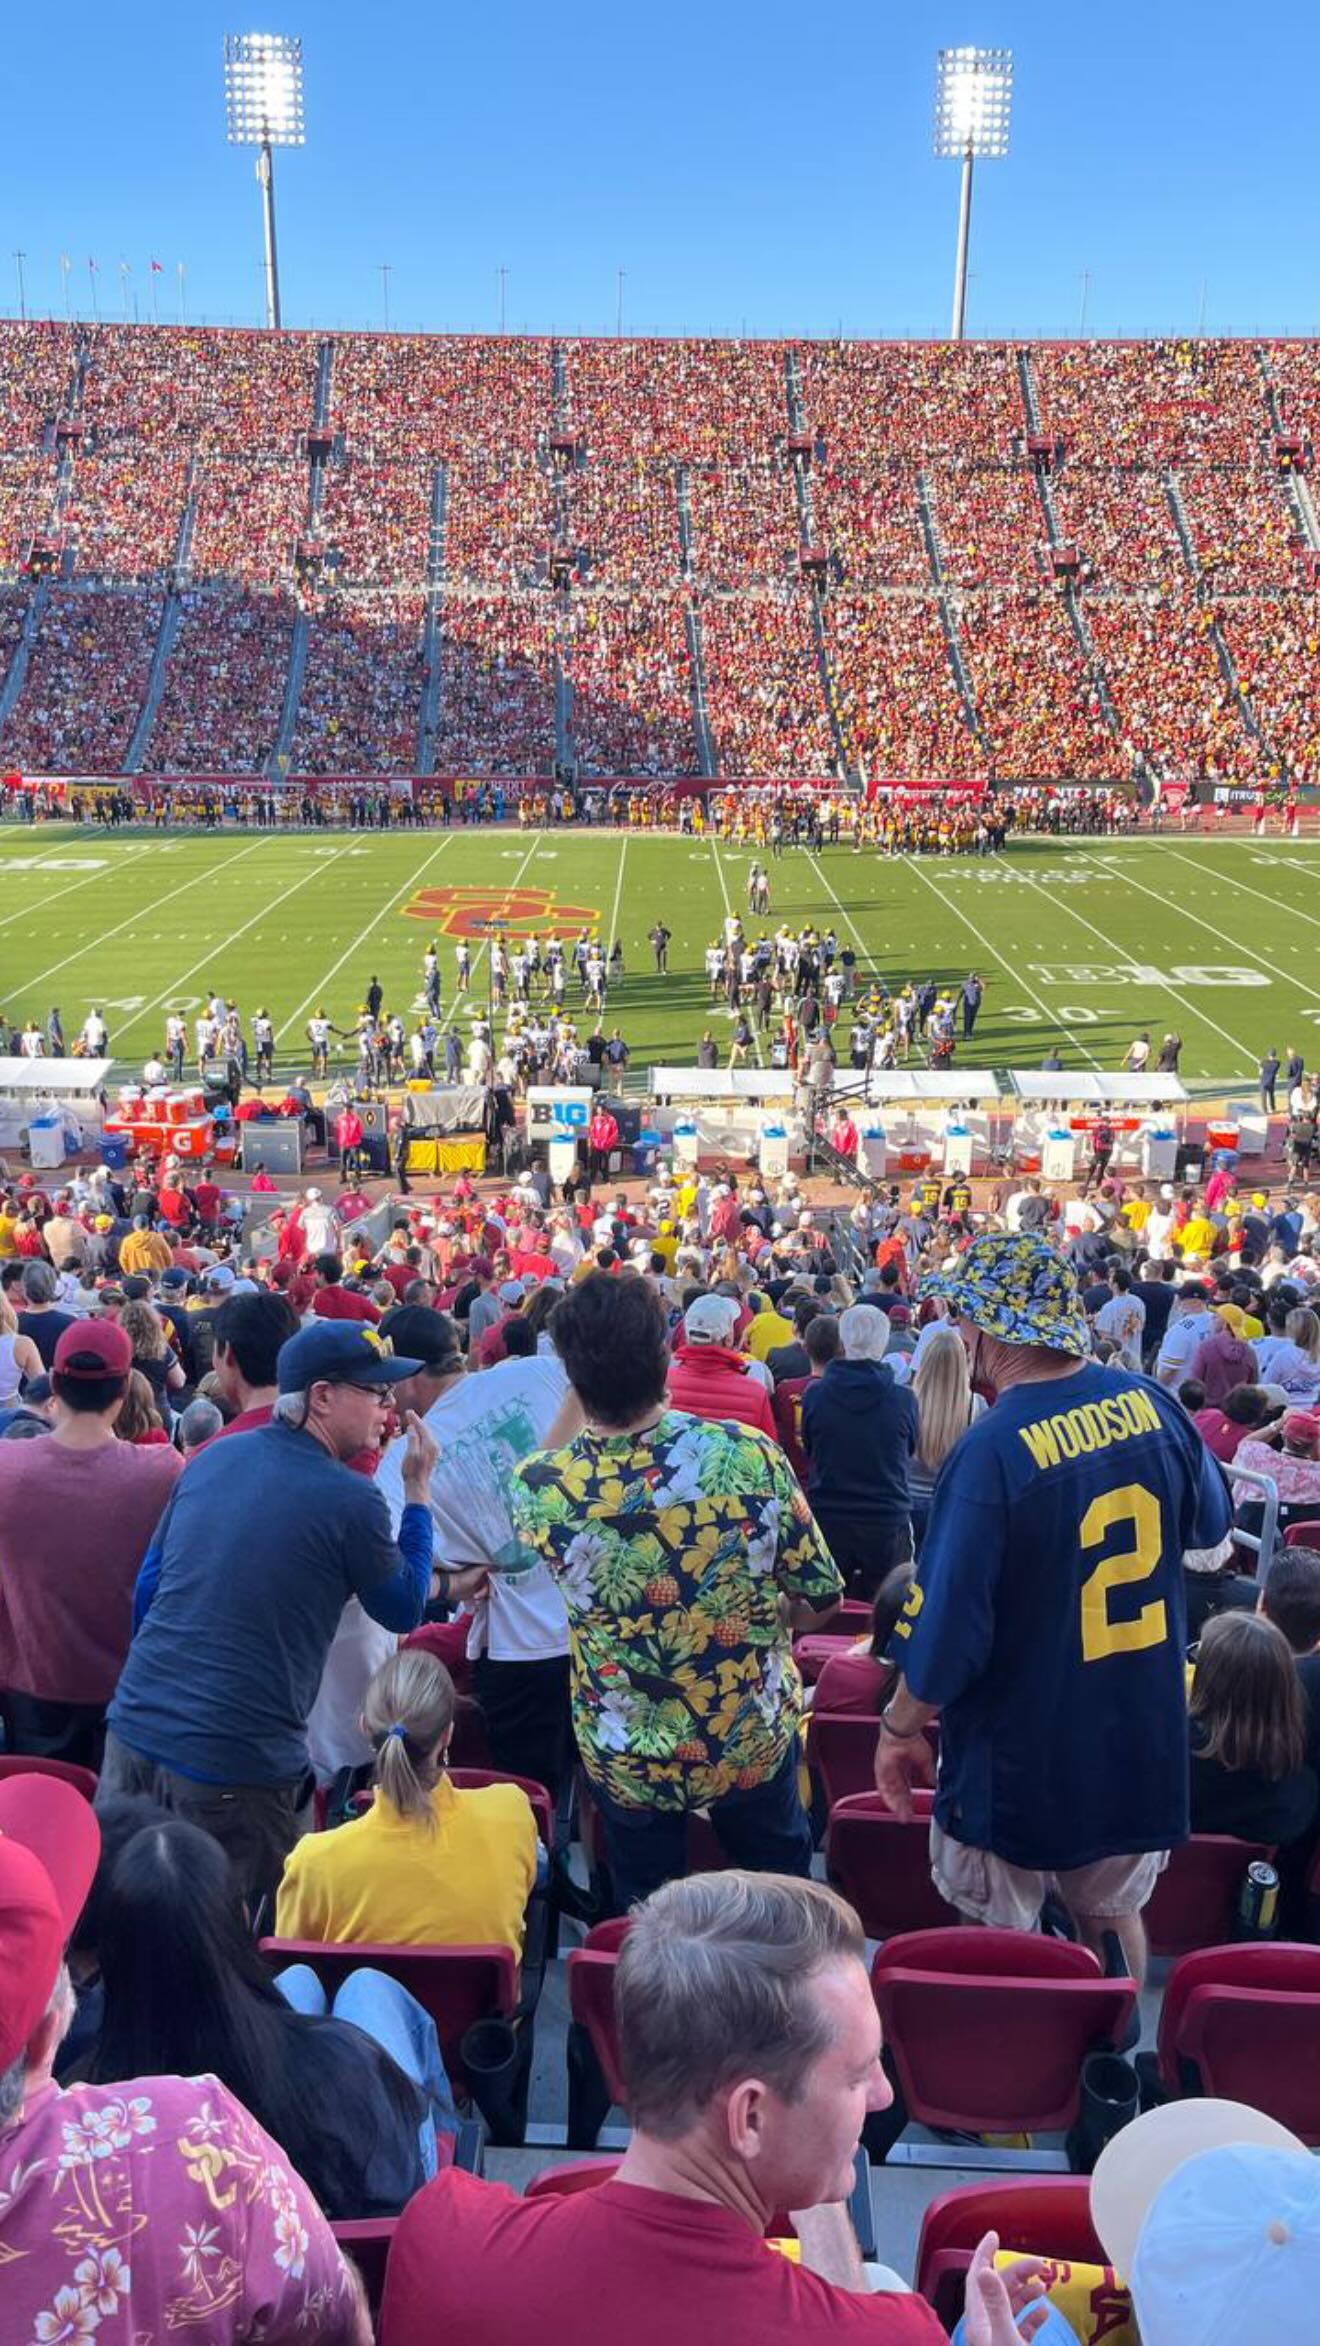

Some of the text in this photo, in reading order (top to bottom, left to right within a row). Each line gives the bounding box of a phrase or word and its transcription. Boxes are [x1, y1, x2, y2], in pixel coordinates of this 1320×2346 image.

[172, 1131, 192, 1151] G
[1018, 1388, 1163, 1470] WOODSON
[1079, 1482, 1168, 1663] 2
